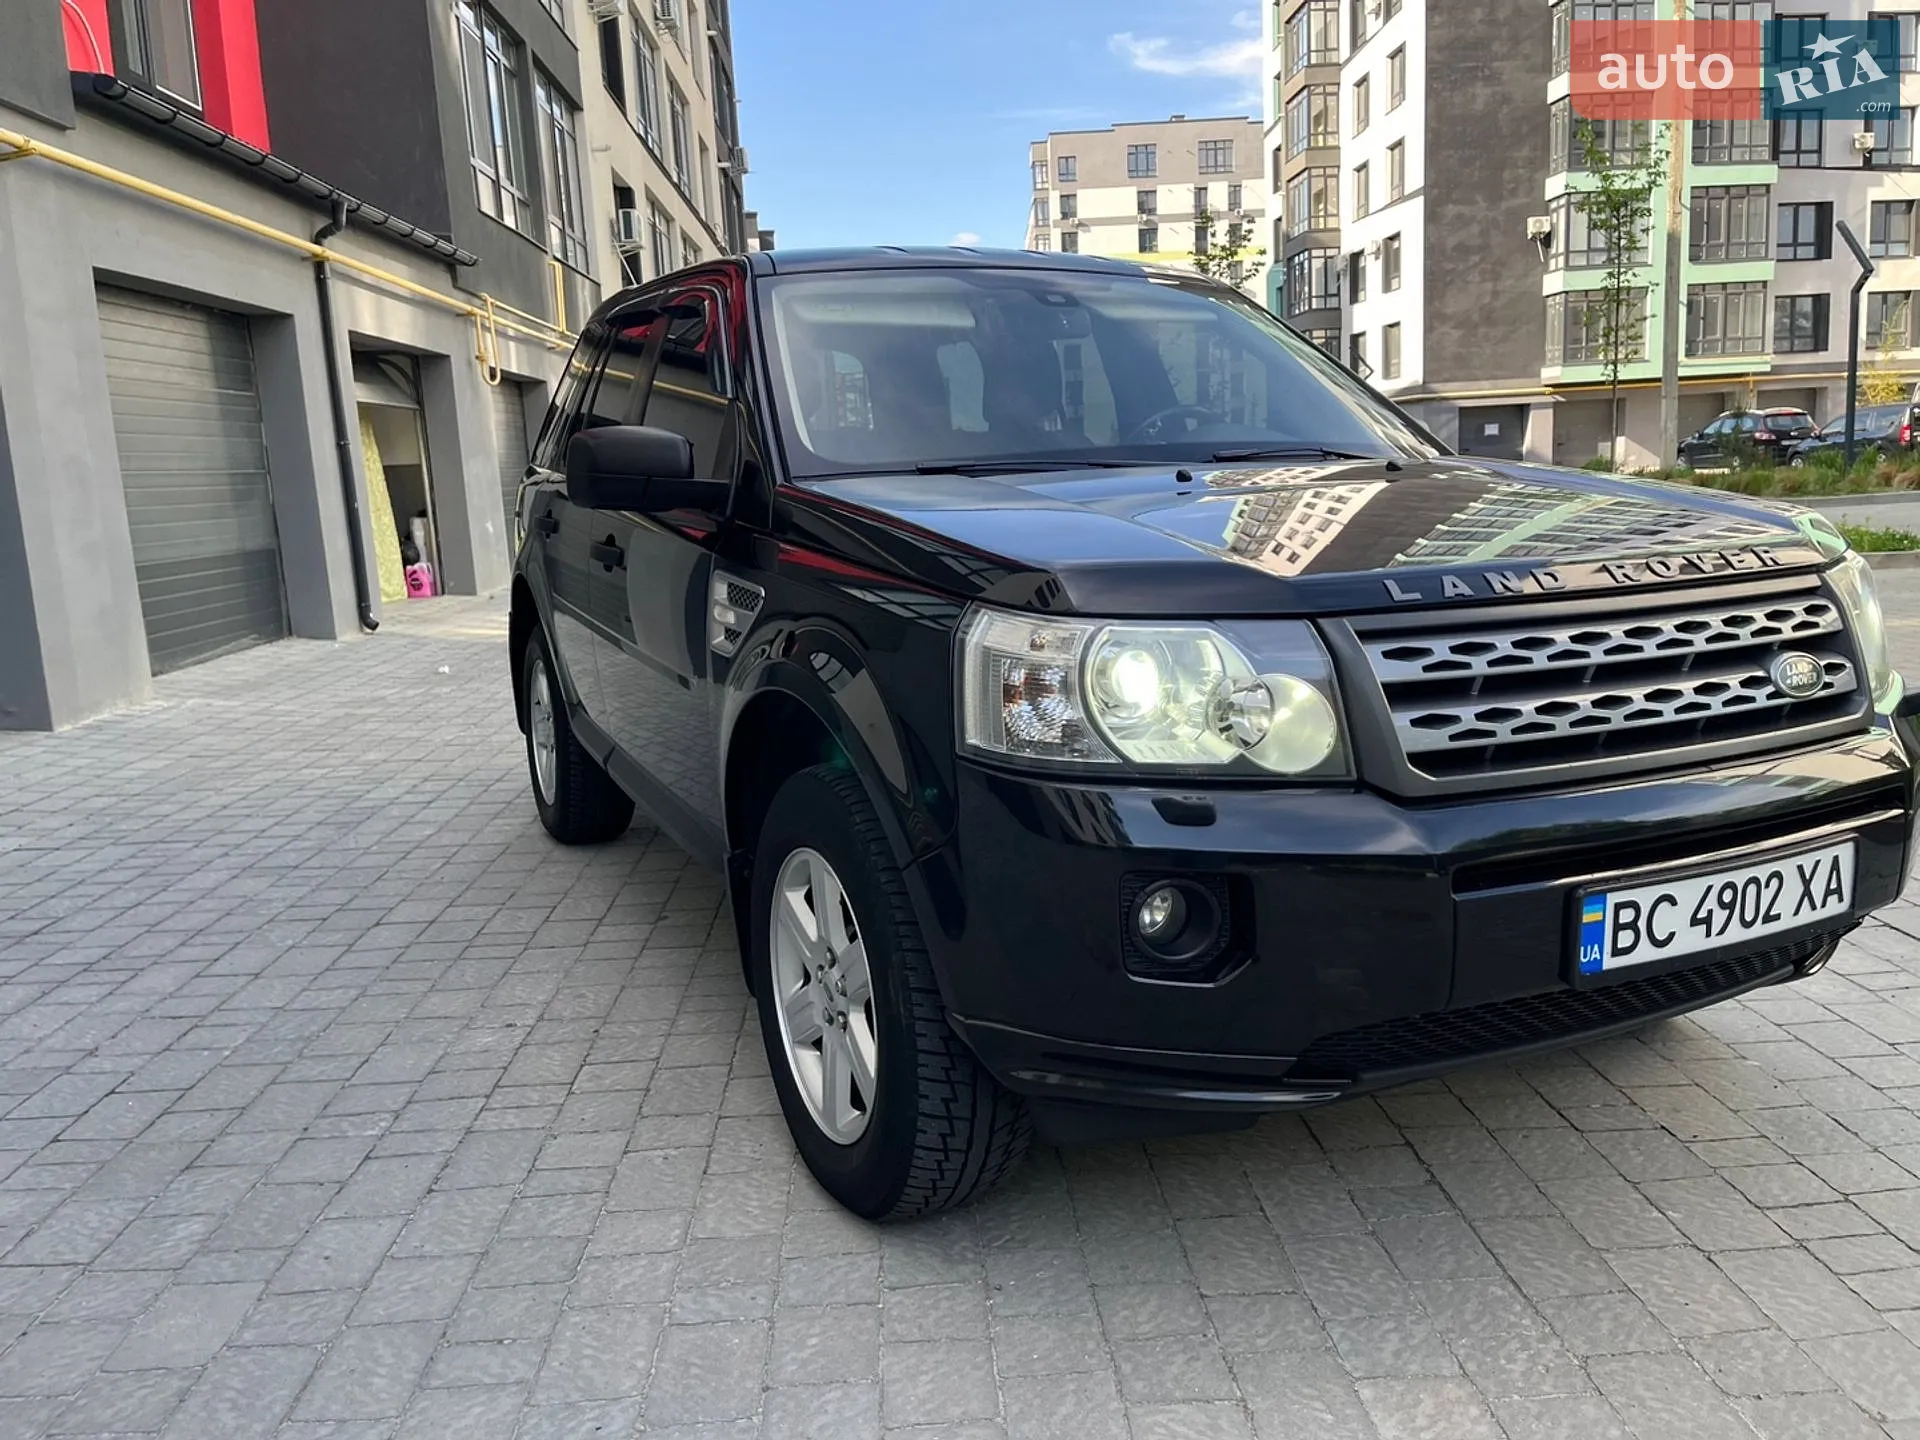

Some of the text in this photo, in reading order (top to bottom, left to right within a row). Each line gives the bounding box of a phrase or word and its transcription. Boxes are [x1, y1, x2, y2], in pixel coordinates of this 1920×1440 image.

[1382, 546, 1785, 602] LAND ROVER
[1610, 854, 1844, 958] BC 4902 XA
[1580, 944, 1601, 963] UA
